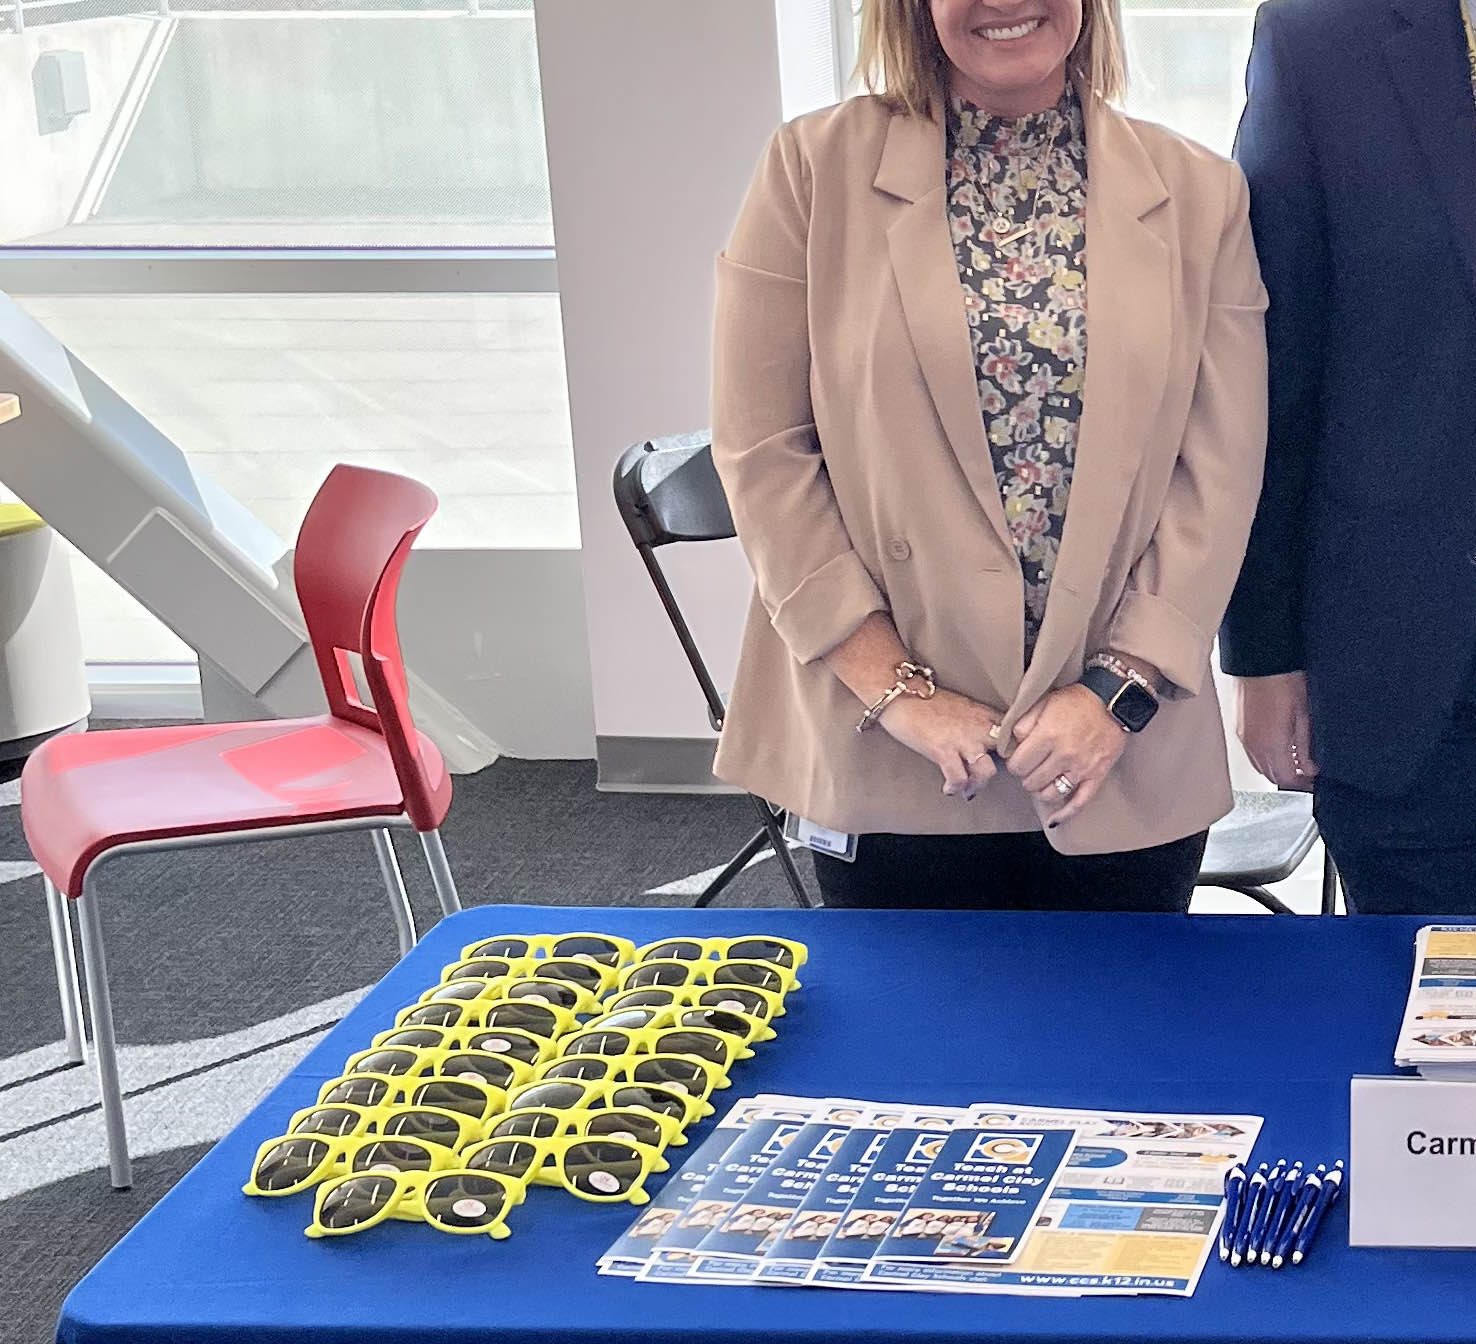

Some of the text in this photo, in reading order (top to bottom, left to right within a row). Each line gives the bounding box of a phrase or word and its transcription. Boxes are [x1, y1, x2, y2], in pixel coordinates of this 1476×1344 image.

[953, 1162, 1034, 1176] Teach at
[930, 1172, 1045, 1187] Carmel Clay
[942, 1183, 1020, 1195] Schools
